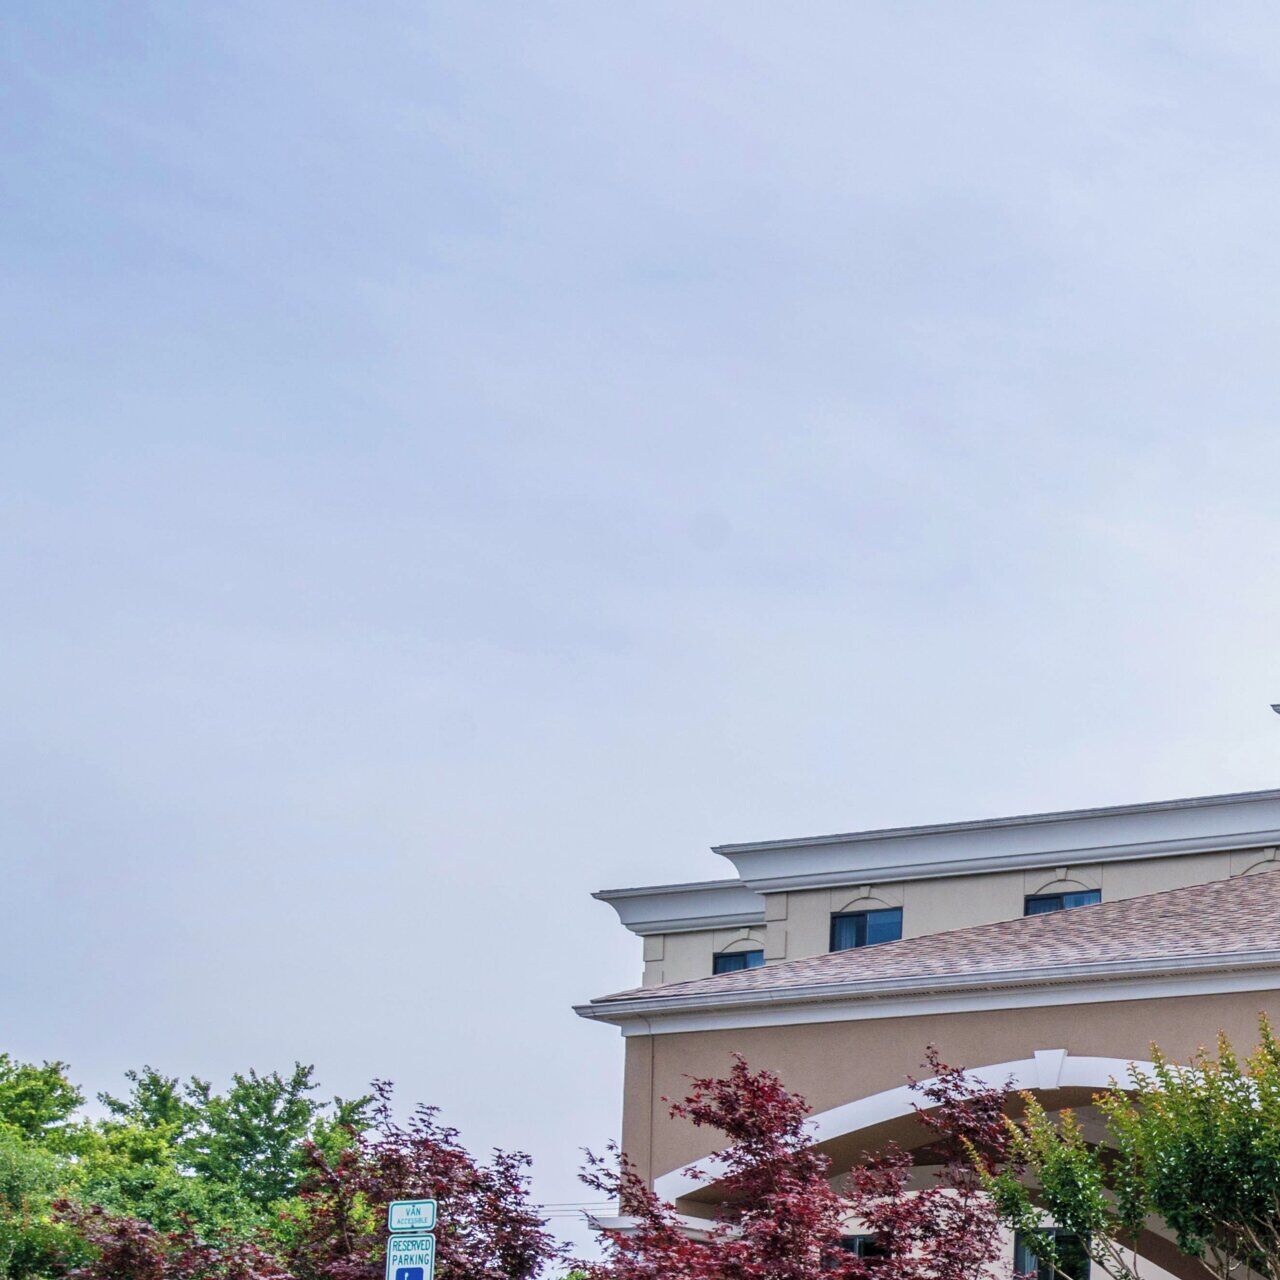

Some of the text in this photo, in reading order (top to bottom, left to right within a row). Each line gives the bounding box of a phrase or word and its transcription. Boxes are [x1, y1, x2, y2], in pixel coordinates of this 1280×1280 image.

[405, 1207, 421, 1216] VAN
[392, 1239, 431, 1251] RESERVED
[392, 1253, 430, 1266] PARKING
